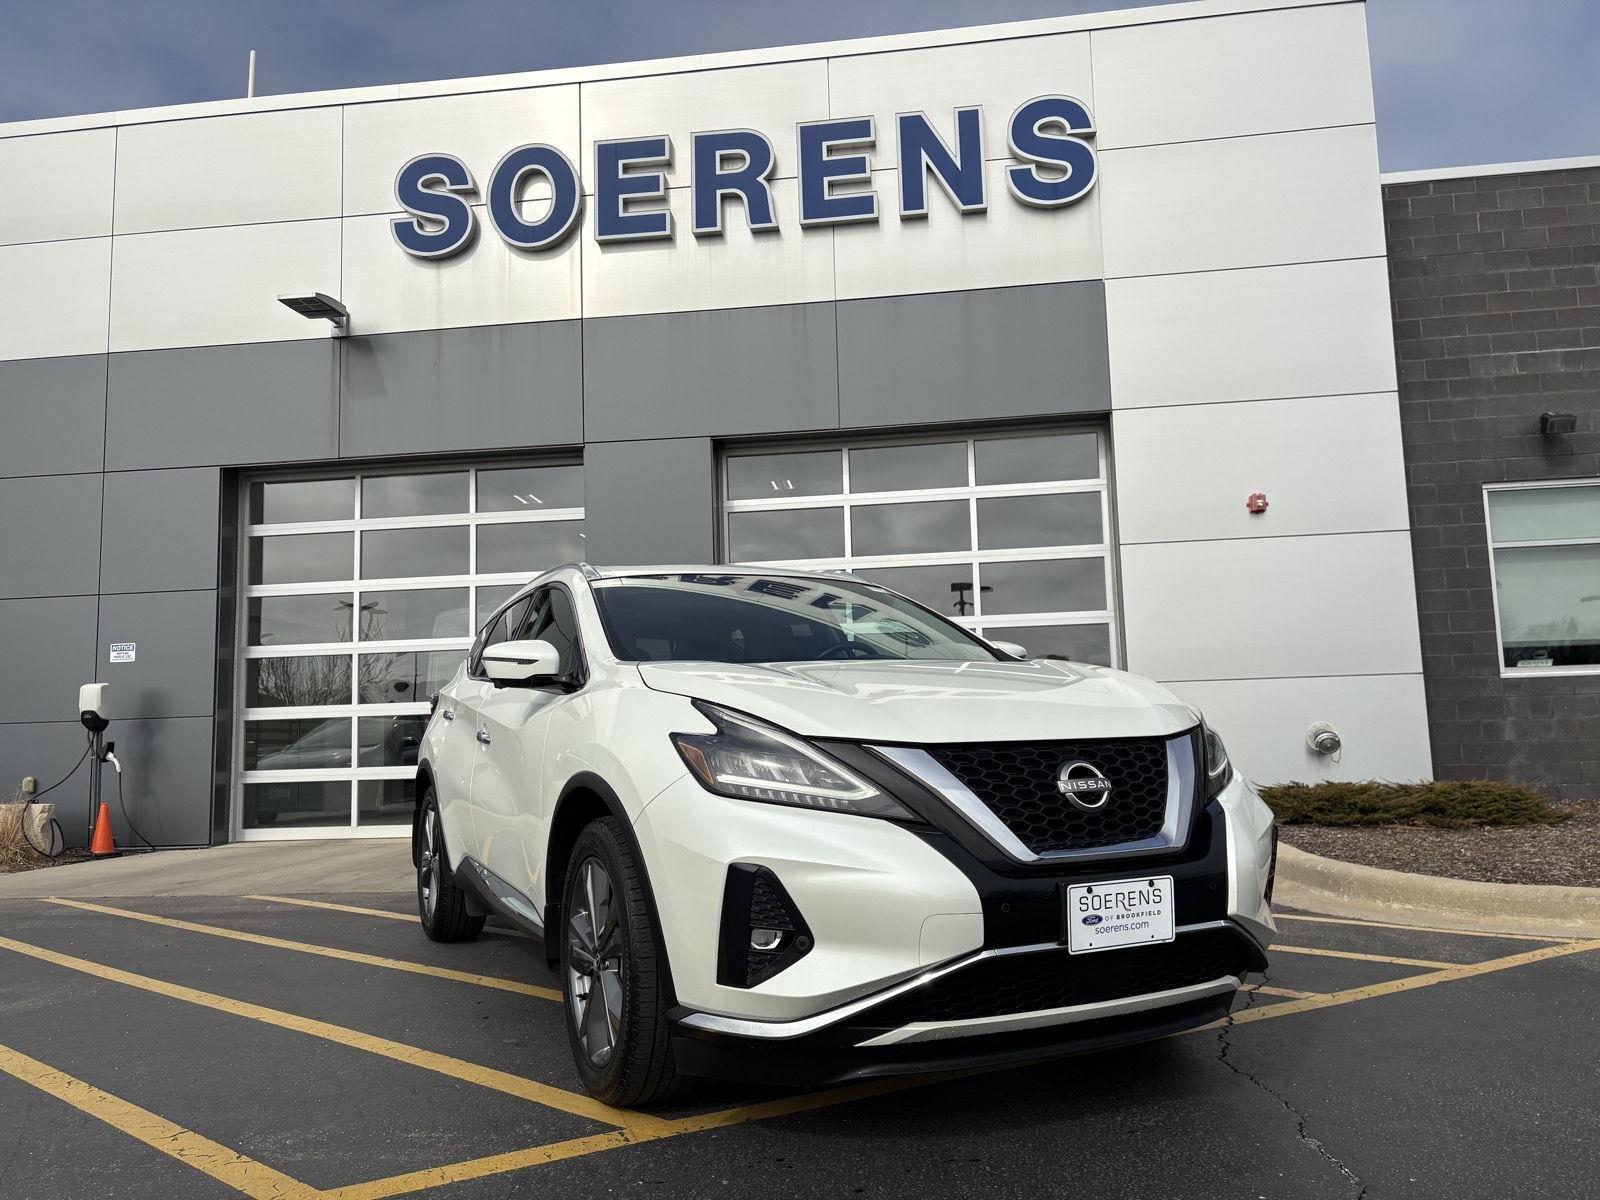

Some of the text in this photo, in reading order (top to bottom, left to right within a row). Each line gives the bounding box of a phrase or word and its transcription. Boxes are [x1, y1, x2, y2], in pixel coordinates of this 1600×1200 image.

[390, 94, 1099, 260] SOERENS
[1060, 780, 1112, 790] NISSAN
[1079, 888, 1162, 912] SOERENS
[1116, 910, 1162, 920] BROOKFIELD
[1095, 921, 1150, 934] soerens.com
